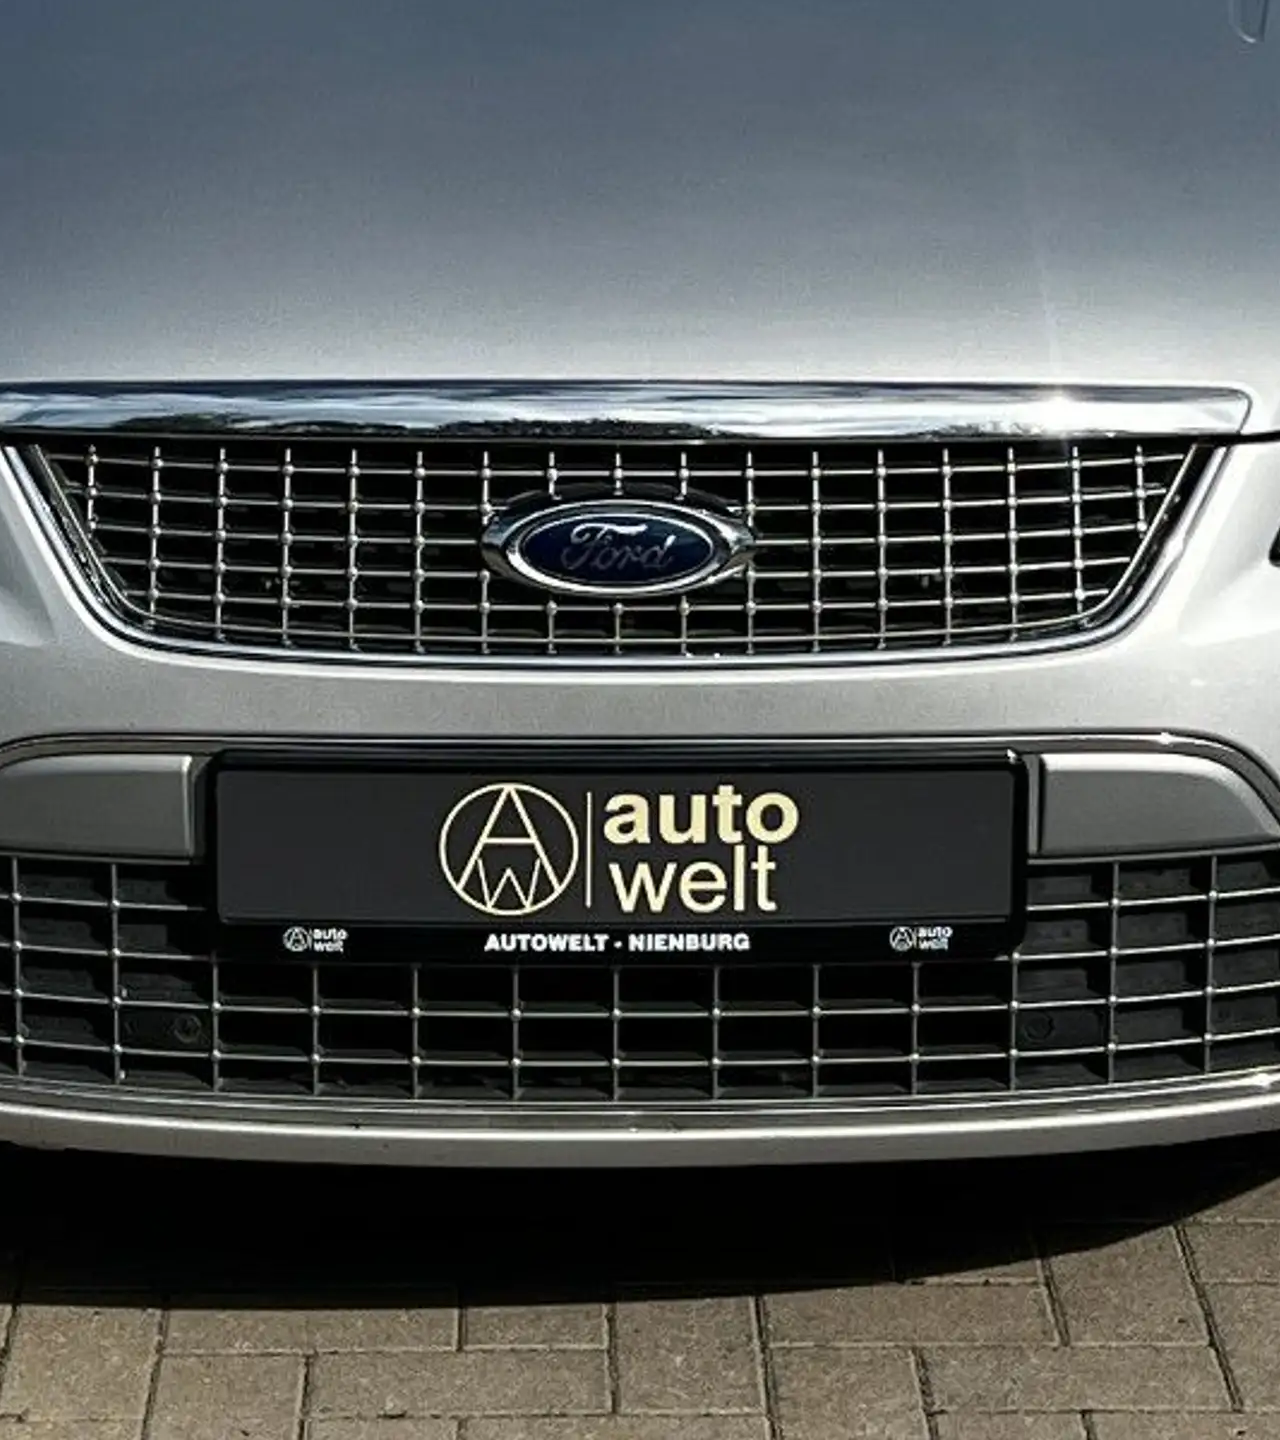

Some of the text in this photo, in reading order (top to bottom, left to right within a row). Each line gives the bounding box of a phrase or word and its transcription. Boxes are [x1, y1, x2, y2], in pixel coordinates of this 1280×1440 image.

[561, 522, 676, 570] Ford
[602, 784, 800, 844] auto
[609, 844, 778, 912] welt
[484, 933, 609, 951] AUTOWELT
[627, 933, 751, 951] NIENBURG
